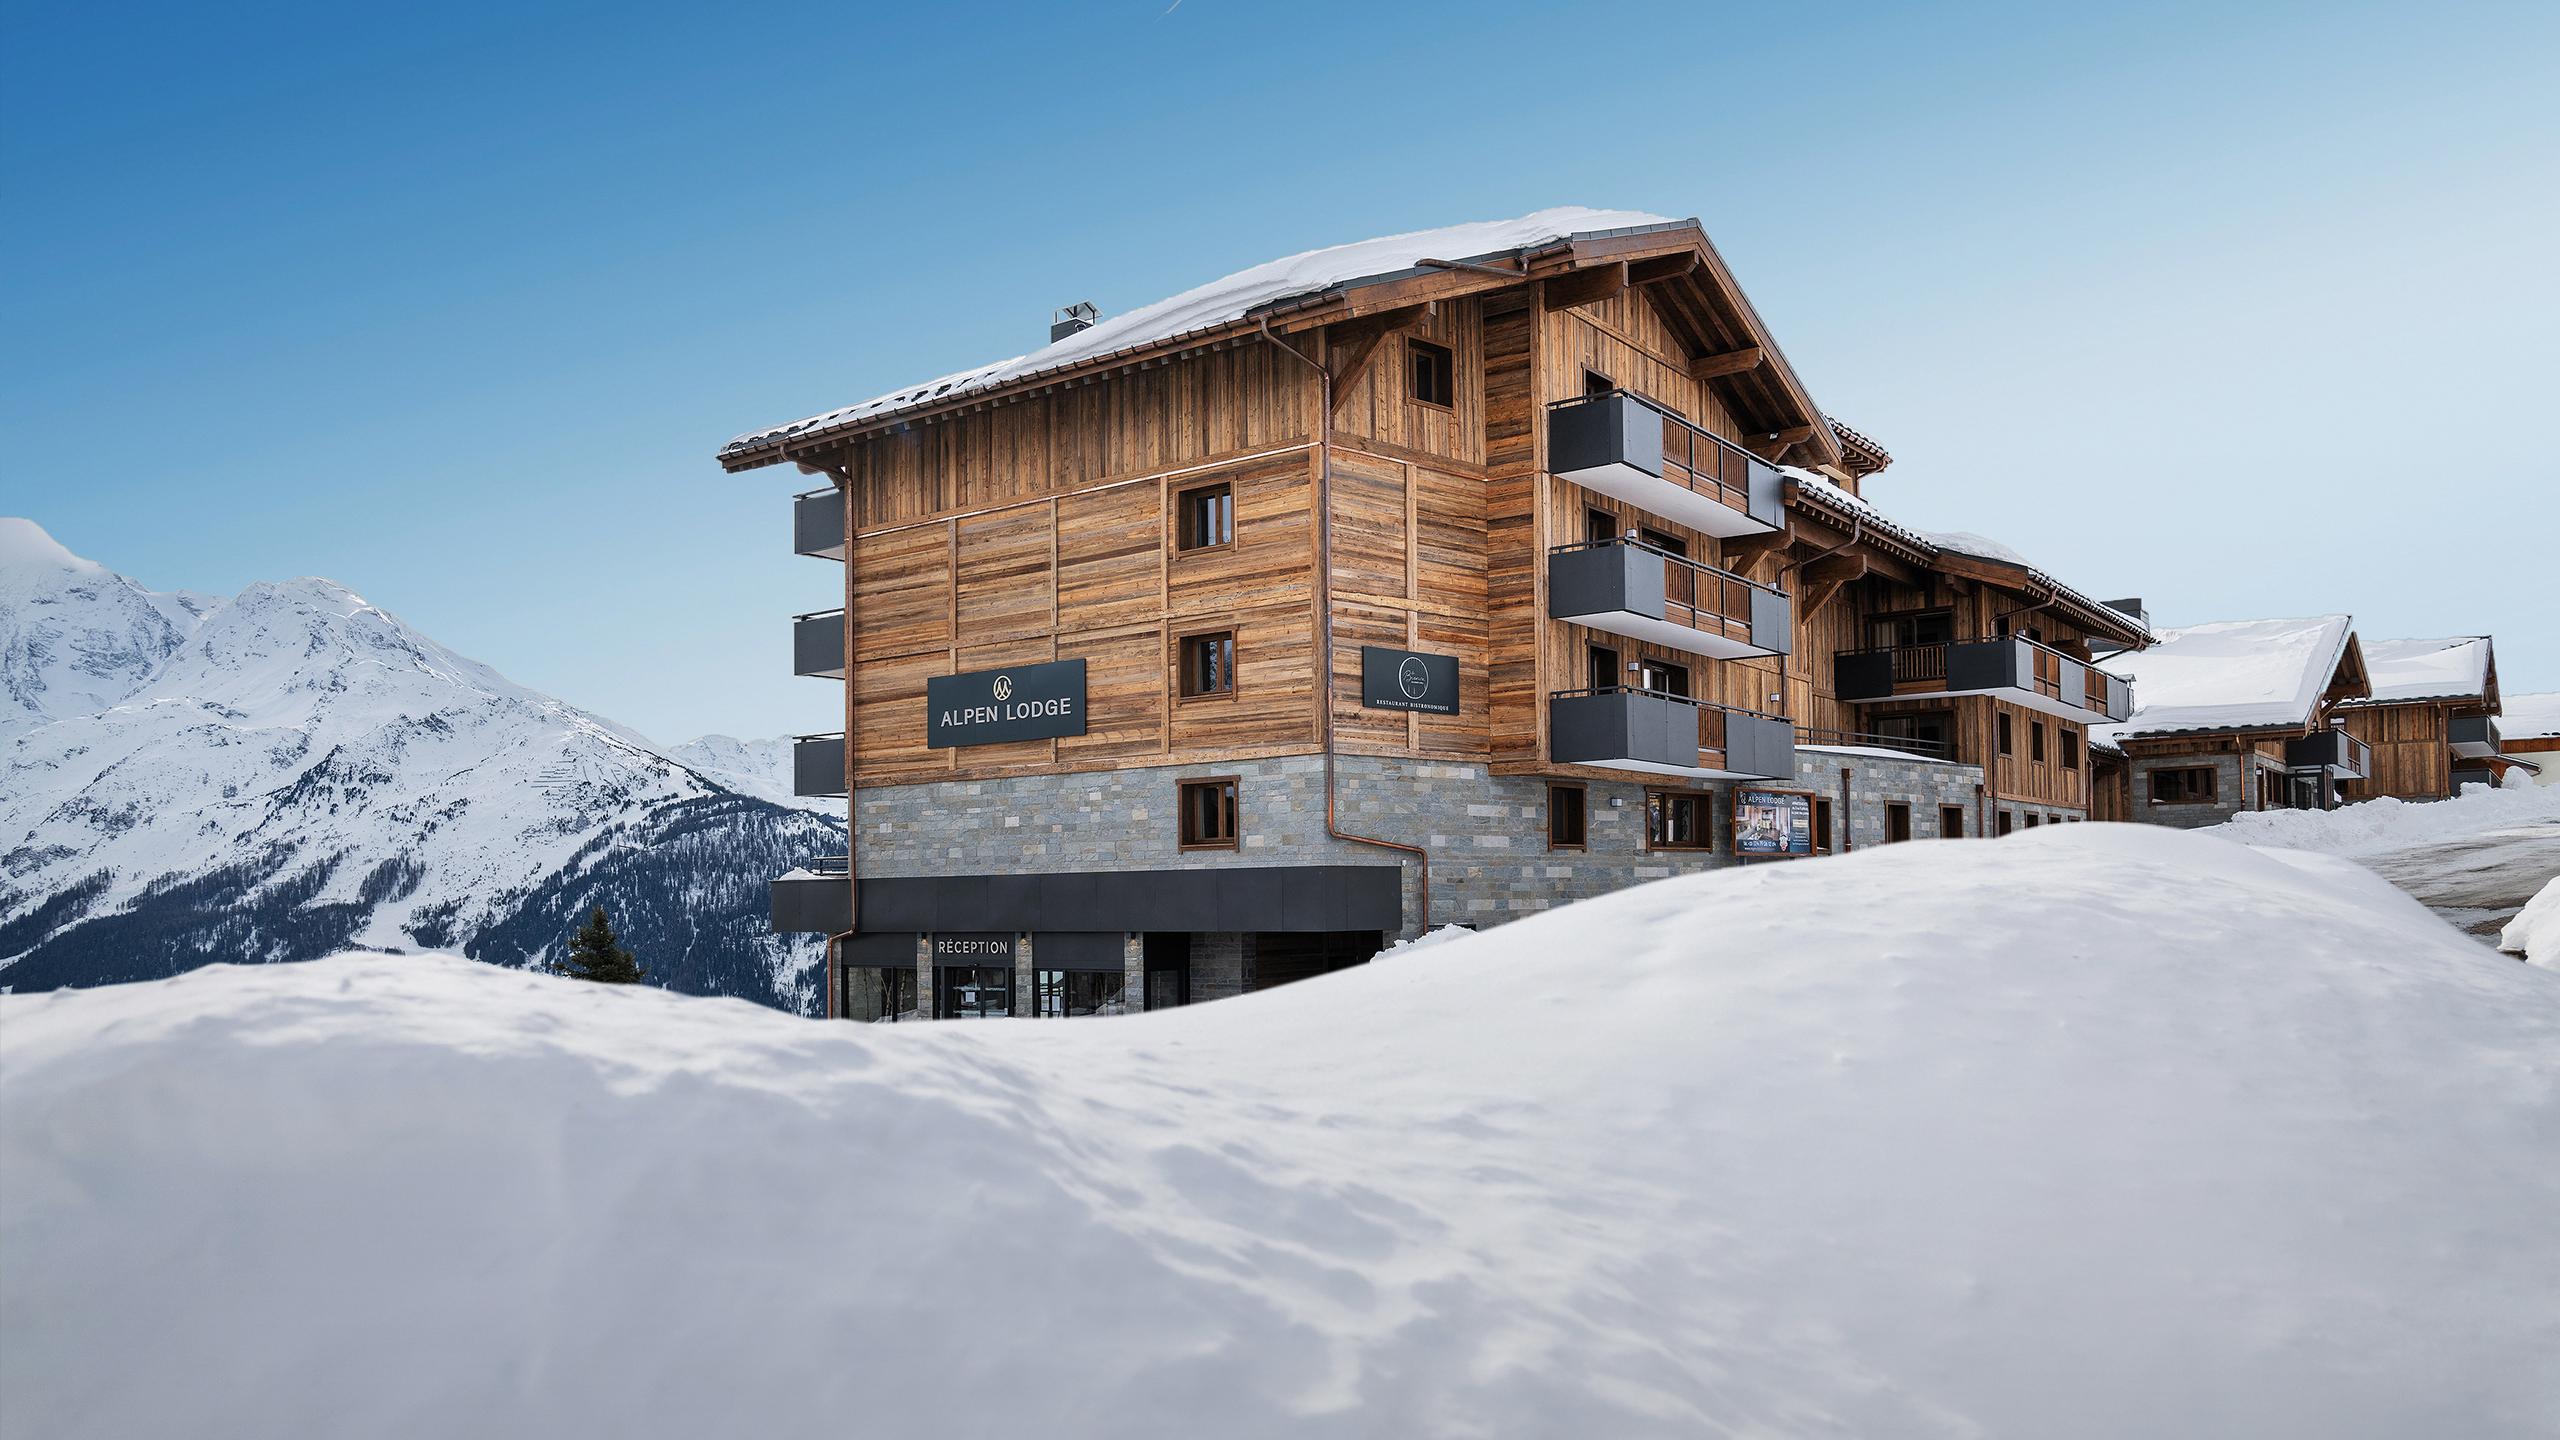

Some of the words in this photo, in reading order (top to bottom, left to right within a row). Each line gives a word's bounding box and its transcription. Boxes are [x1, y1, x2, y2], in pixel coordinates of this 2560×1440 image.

[1376, 699, 1408, 707] RESTAURANT
[1410, 702, 1449, 711] BISTRONOMIQUE
[940, 705, 998, 727] ALPEN
[1006, 698, 1072, 721] LODGE
[1748, 796, 1766, 804] ALPEN
[1767, 797, 1785, 805] LODGE
[938, 938, 1008, 954] RÉCEPTION
